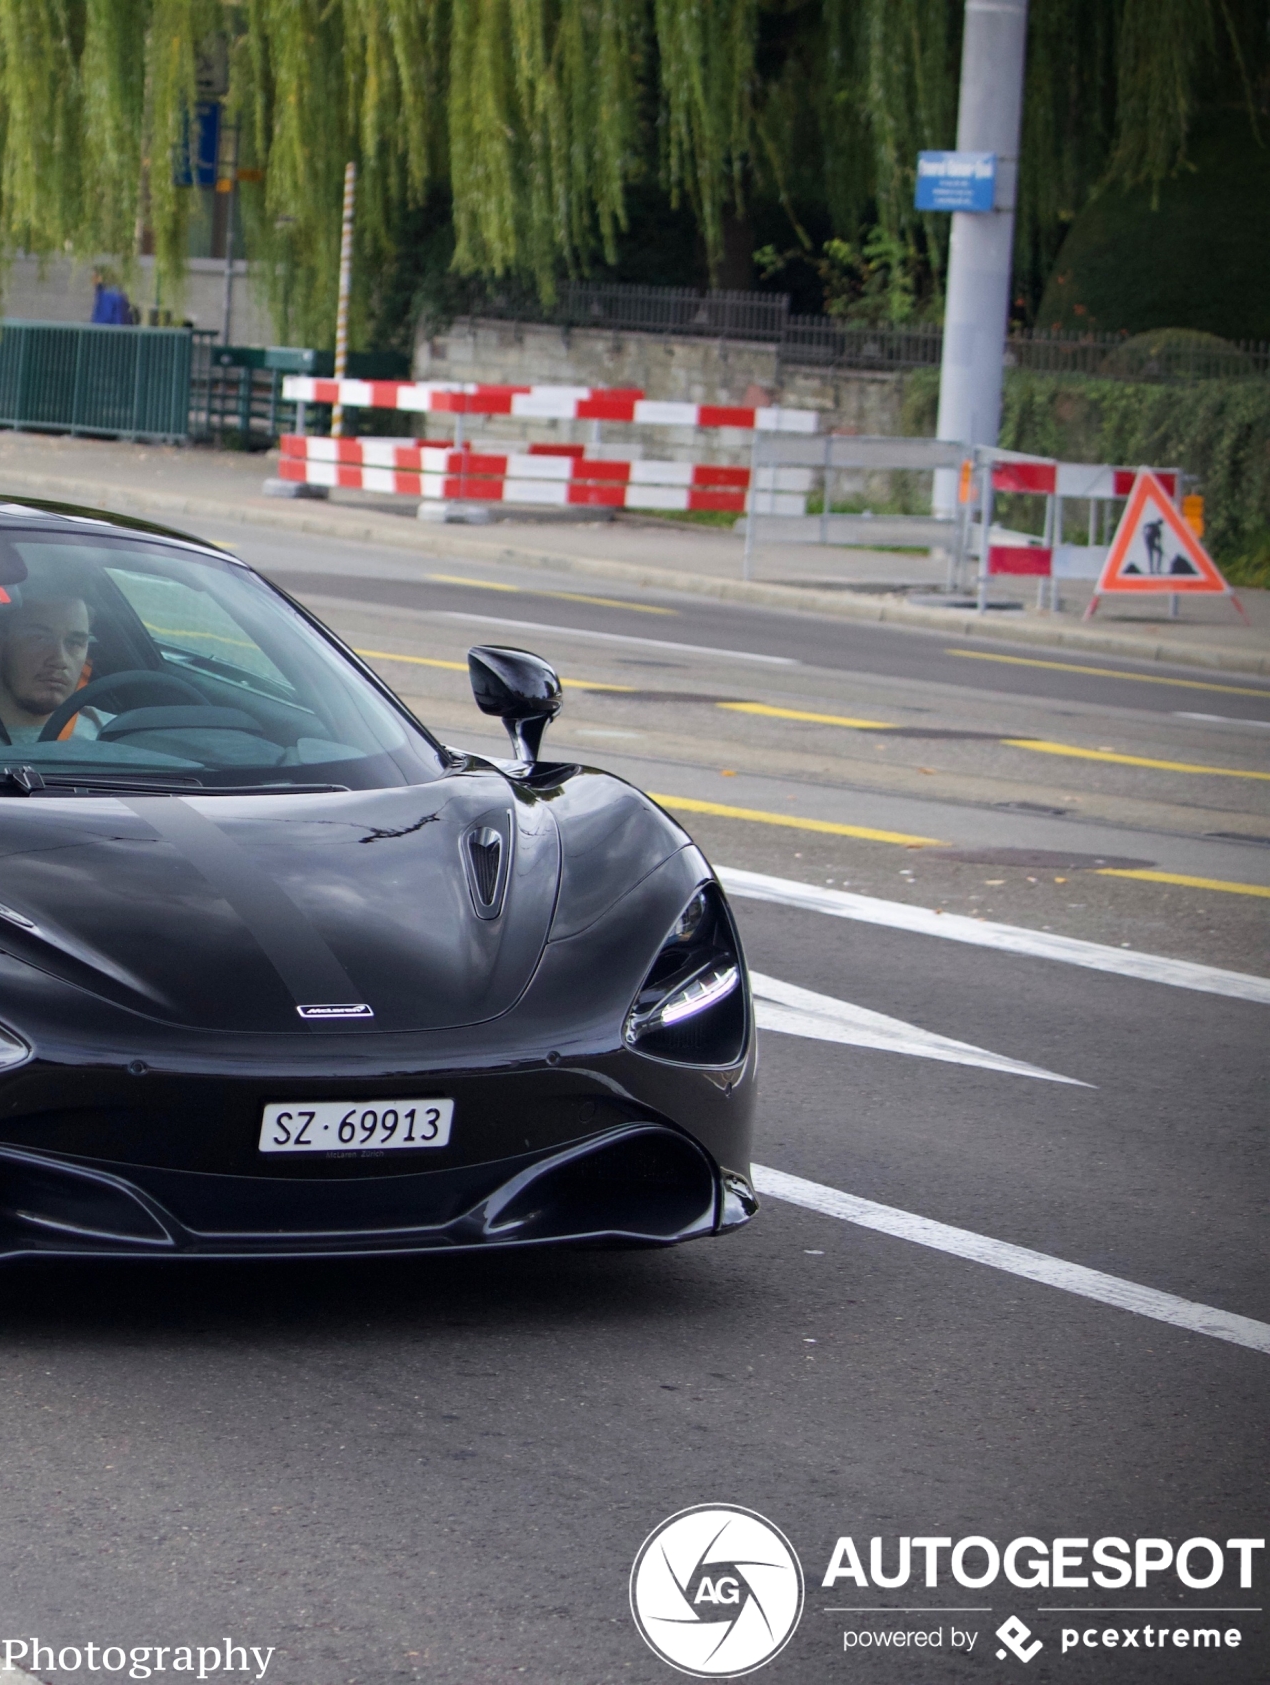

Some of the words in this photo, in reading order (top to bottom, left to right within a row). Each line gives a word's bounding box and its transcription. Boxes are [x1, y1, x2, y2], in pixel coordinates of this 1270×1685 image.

[306, 1006, 363, 1015] McLaren
[325, 1151, 357, 1159] McLaren
[360, 1150, 385, 1158] Zürich
